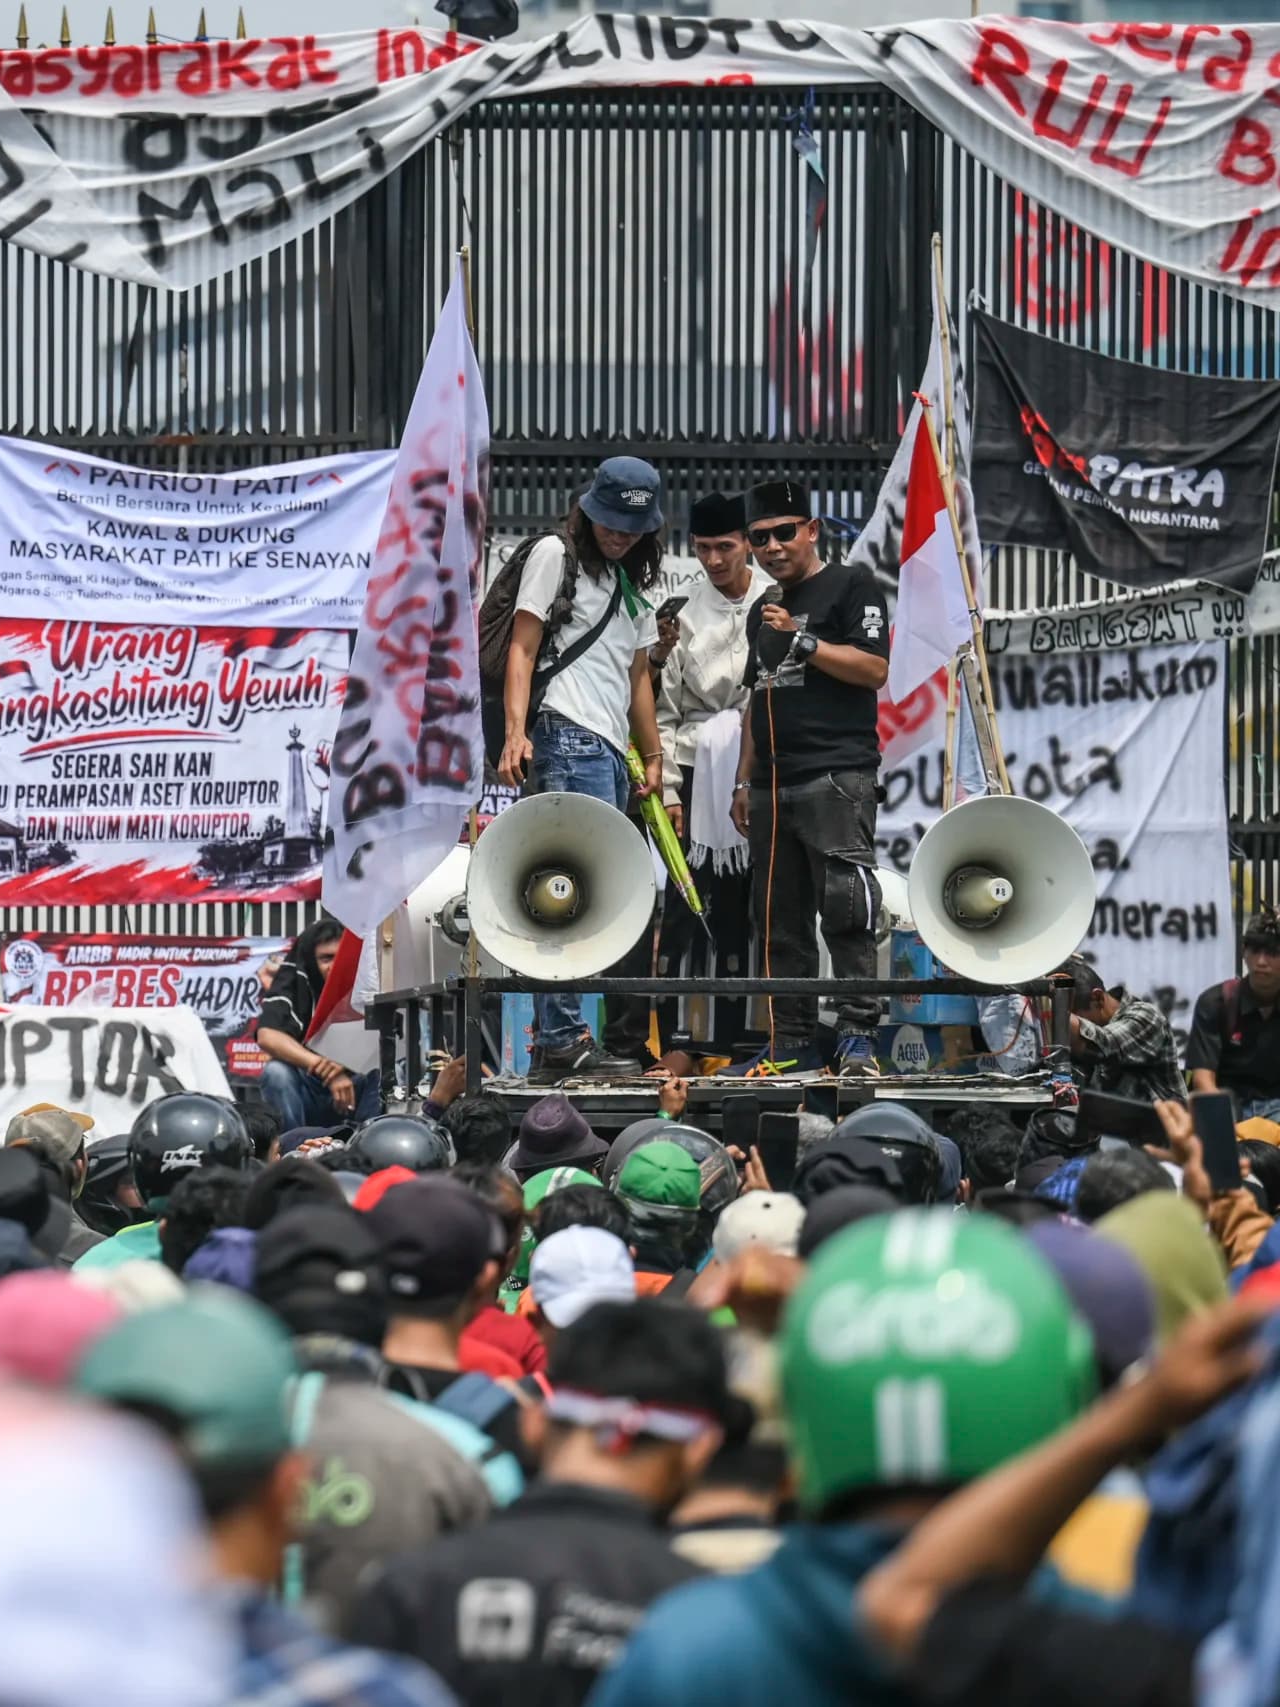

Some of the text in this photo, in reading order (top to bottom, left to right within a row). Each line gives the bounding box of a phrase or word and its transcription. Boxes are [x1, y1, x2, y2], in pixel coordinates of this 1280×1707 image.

[970, 28, 1172, 177] RUU
[89, 466, 298, 496] PATRIOT PATI
[1089, 454, 1224, 508] PATRA
[56, 489, 111, 507] Berani
[116, 495, 191, 513] Bersuara
[196, 500, 245, 514] Untuk
[87, 520, 296, 544] KAWAL & DUKUNG
[1129, 508, 1221, 531] NUSANTARA
[9, 540, 371, 569] MASYARAKAT PATI KE SENAYAN
[25, 570, 83, 585] Semangat
[1030, 599, 1203, 652] BANGSAT
[42, 620, 197, 679] Urang
[217, 657, 327, 733] Yeuuh
[50, 752, 212, 782] SEGERA SAH KAN
[14, 783, 134, 810] PERAMPASAN
[141, 781, 184, 808] ASET
[190, 779, 279, 806] KORUPTOR
[25, 816, 58, 843] DAN
[63, 815, 121, 842] HUKUM
[126, 814, 164, 841] MATI
[181, 976, 259, 1014] HADIR
[897, 1042, 927, 1064] AQUA
